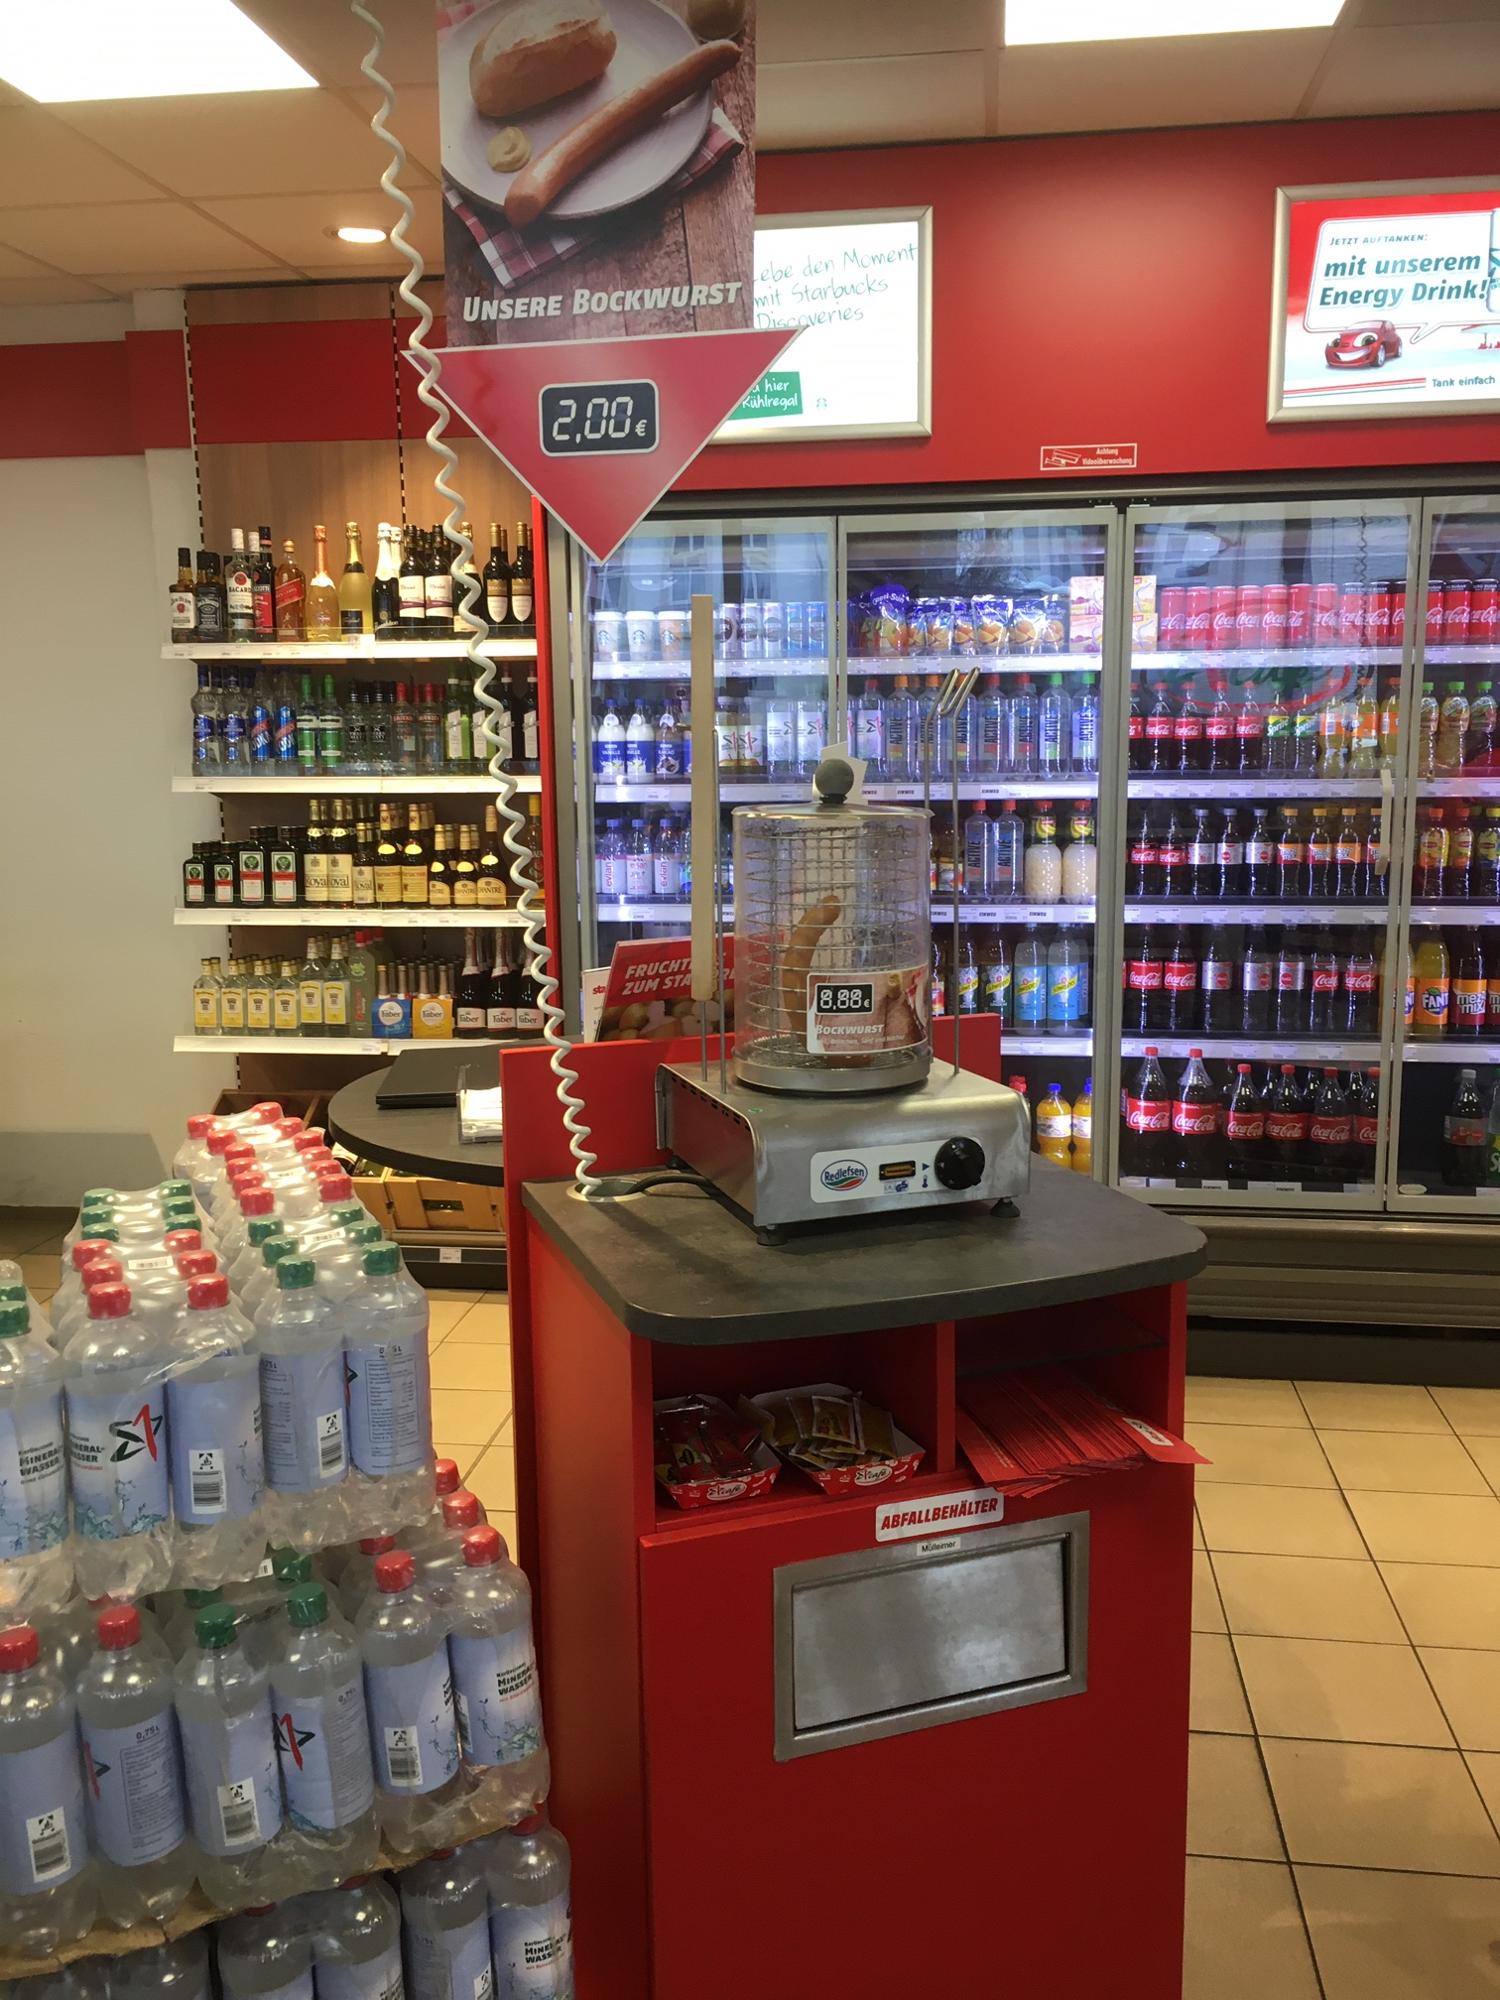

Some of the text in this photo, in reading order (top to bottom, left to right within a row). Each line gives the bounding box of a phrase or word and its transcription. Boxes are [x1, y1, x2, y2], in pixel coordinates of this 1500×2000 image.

[754, 243, 918, 283] ebe den Moment
[1325, 255, 1481, 277] mit unserem
[754, 273, 888, 308] mit Starbucks
[1319, 279, 1488, 308] Energy Drink!
[463, 281, 742, 322] UNSERE BOCKWURST
[764, 378, 790, 393] hier
[1432, 375, 1495, 388] Tank einfach
[1096, 448, 1118, 456] Achtung
[890, 717, 902, 744] ACTIVE
[983, 716, 998, 743] ACTIVE
[1045, 716, 1058, 742] ACTIVE
[968, 840, 981, 867] ACTIVE
[998, 840, 1012, 867] ACTIVE
[605, 861, 613, 887] evian
[661, 861, 669, 887] evian
[622, 978, 659, 996] ZUM
[1129, 971, 1161, 986] Coca-Cola
[381, 1010, 401, 1018] Faber
[422, 1010, 442, 1018] Faber
[459, 1014, 479, 1023] Faber
[493, 1014, 512, 1023] Faber
[519, 1014, 537, 1024] Faber
[816, 1024, 885, 1035] BOCKWURST
[1130, 1111, 1169, 1128] Coca-Cola
[1175, 1114, 1216, 1131] Coca-Cola
[1228, 1121, 1263, 1137] Coca-Cola
[1265, 1120, 1302, 1137] Coca-Cola
[1311, 1124, 1350, 1140] Coca-Cola
[824, 1166, 865, 1182] Redlefsen
[19, 1457, 60, 1477] WASSER
[880, 1497, 998, 1530] ABFALLBEHÄLTER
